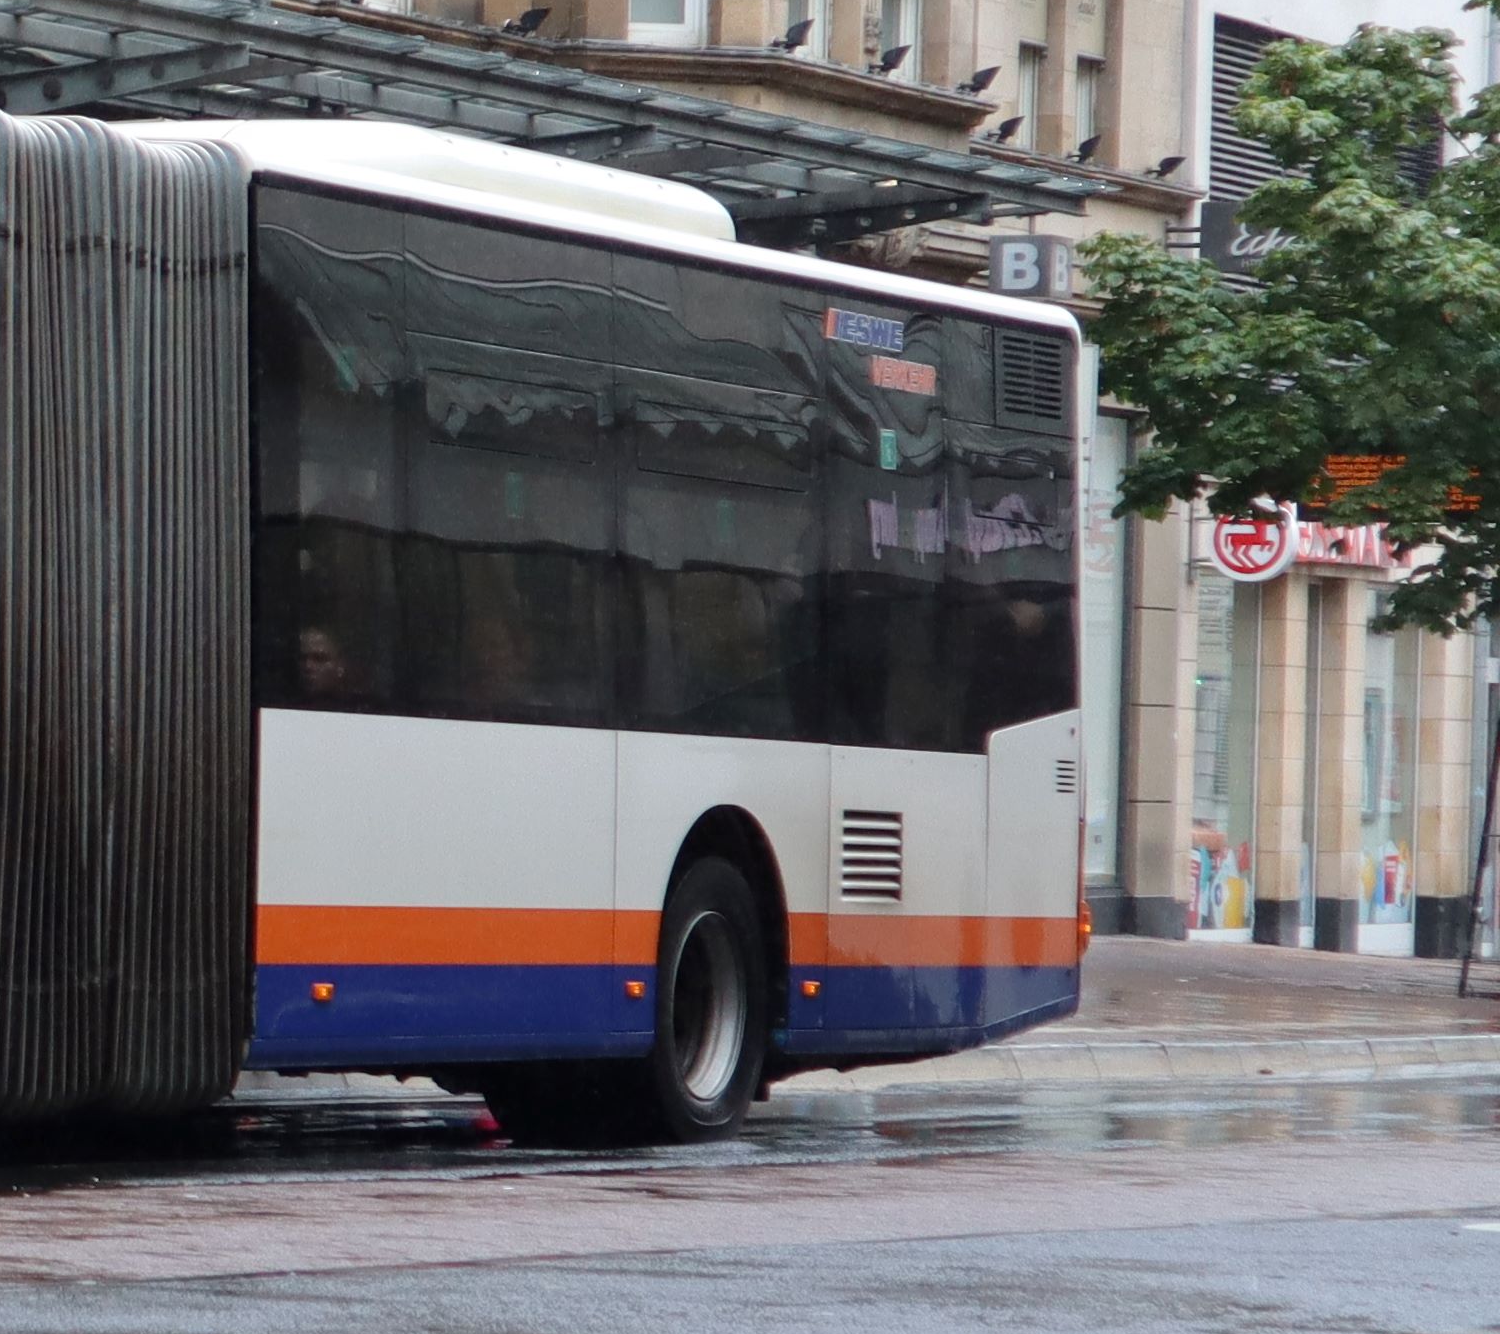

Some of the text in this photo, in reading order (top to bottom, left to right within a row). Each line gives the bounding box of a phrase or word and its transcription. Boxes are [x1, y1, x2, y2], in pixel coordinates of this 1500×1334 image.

[1001, 241, 1041, 291] B
[1054, 242, 1070, 292] B
[838, 312, 904, 352] ESWE
